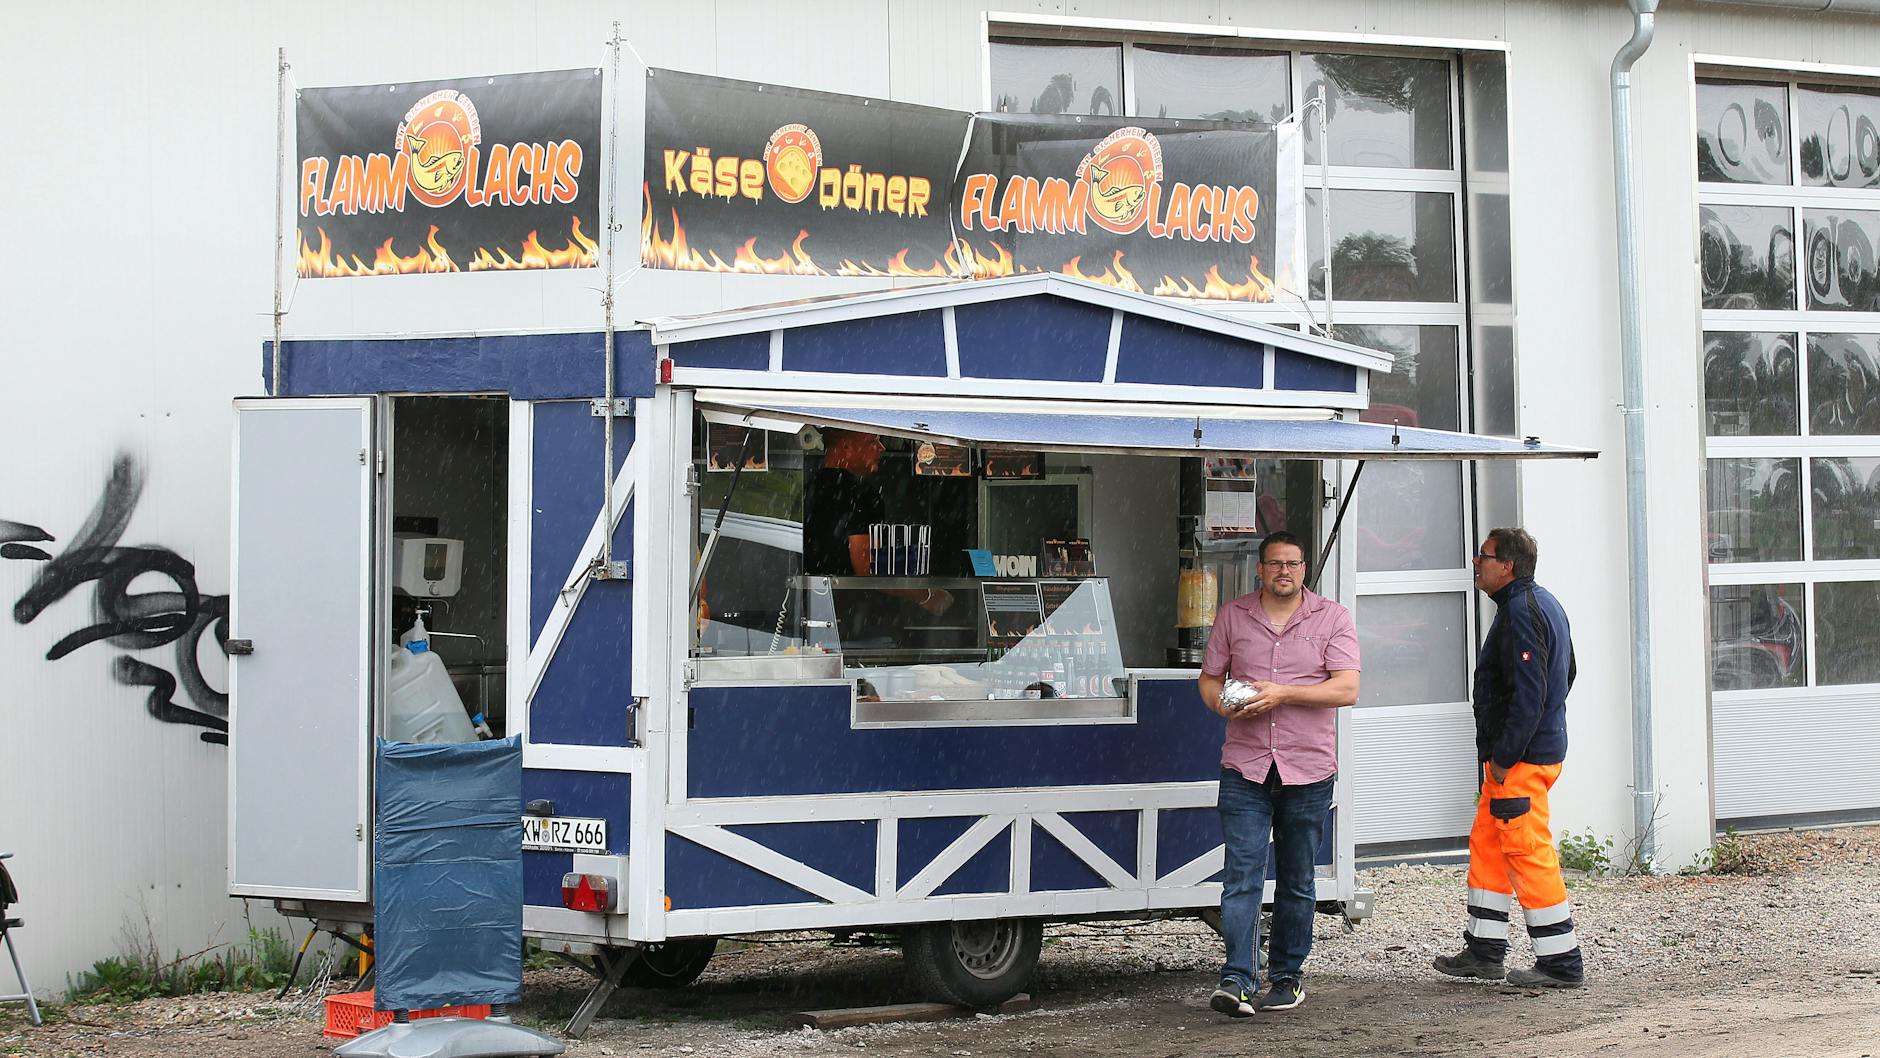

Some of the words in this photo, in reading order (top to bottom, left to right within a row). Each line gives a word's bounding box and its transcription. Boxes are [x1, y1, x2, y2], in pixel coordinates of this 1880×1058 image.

[1093, 127, 1146, 154] SICHERHEIT
[300, 152, 411, 217] FLAMM
[464, 139, 583, 207] LACHS
[663, 146, 766, 205] Käse
[961, 174, 1091, 235] FLAMM
[1147, 180, 1260, 244] LACHS
[993, 555, 1037, 577] MOIN
[522, 819, 541, 842] KW
[552, 822, 571, 843] RZ
[575, 823, 603, 845] 666
